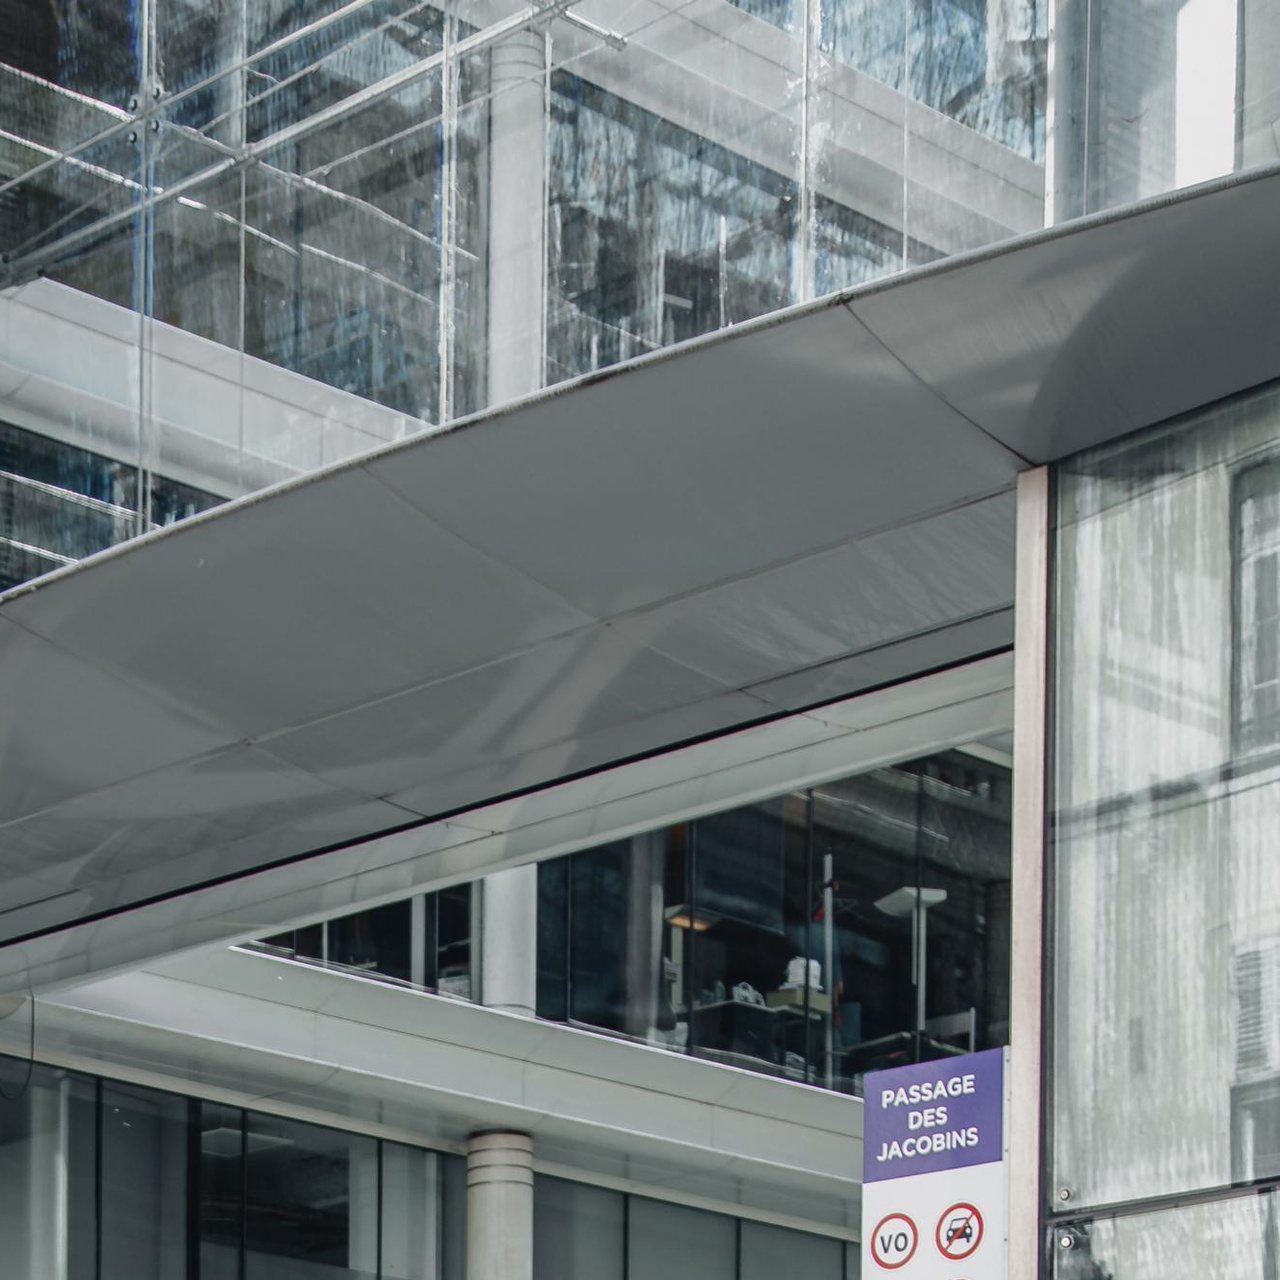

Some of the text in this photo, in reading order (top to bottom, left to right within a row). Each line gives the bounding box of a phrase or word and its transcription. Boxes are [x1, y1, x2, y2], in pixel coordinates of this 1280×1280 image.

[881, 1074, 975, 1109] PASSAGE
[908, 1106, 948, 1130] DES
[876, 1127, 979, 1161] JACOBINS
